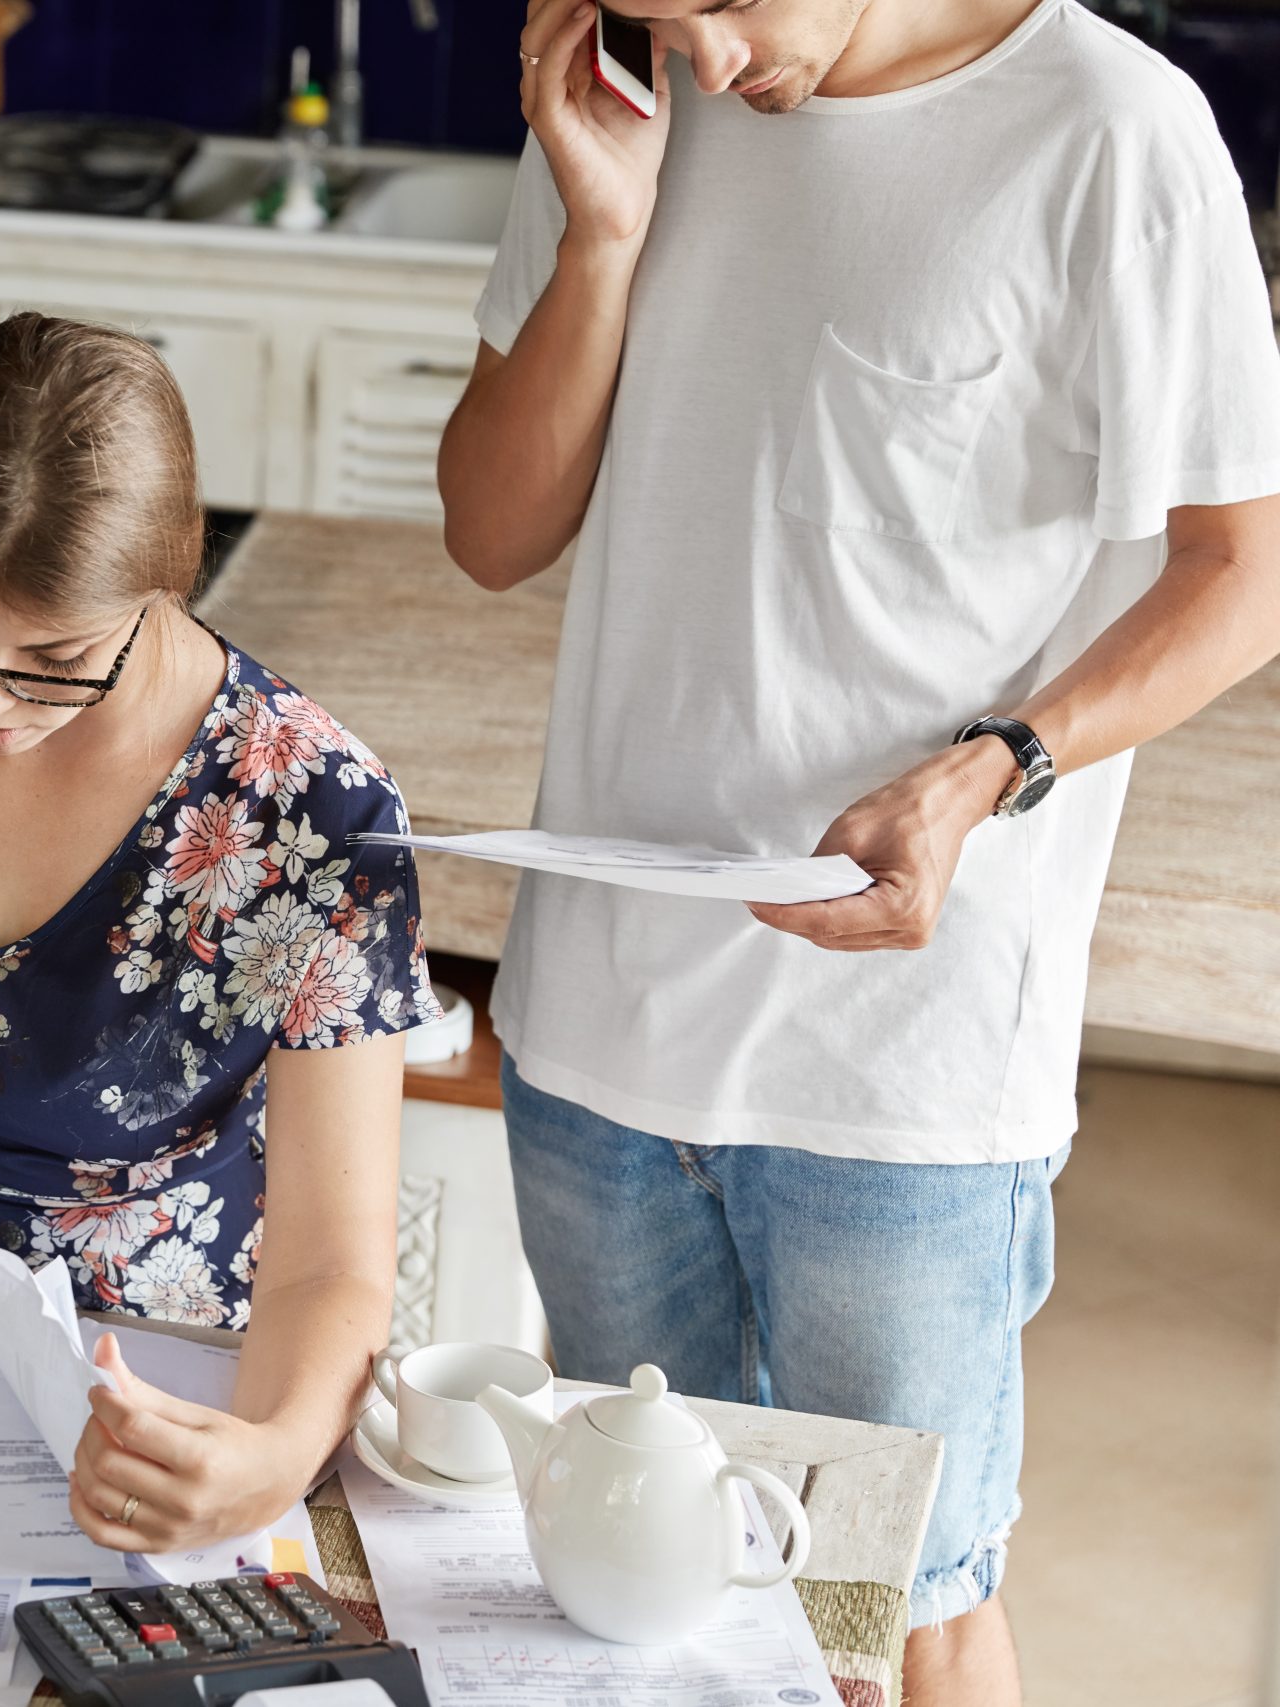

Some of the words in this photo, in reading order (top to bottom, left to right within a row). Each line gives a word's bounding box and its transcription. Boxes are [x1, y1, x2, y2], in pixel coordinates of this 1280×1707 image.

[236, 1577, 248, 1585] 0
[272, 1574, 285, 1582] C
[209, 1593, 222, 1602] 2
[246, 1589, 256, 1597] 1
[176, 1597, 188, 1606] 3
[255, 1601, 266, 1609] 4
[187, 1608, 199, 1618] 6
[219, 1604, 233, 1613] 5
[231, 1616, 244, 1625] 8
[268, 1612, 279, 1620] 7
[198, 1620, 210, 1629] 9
